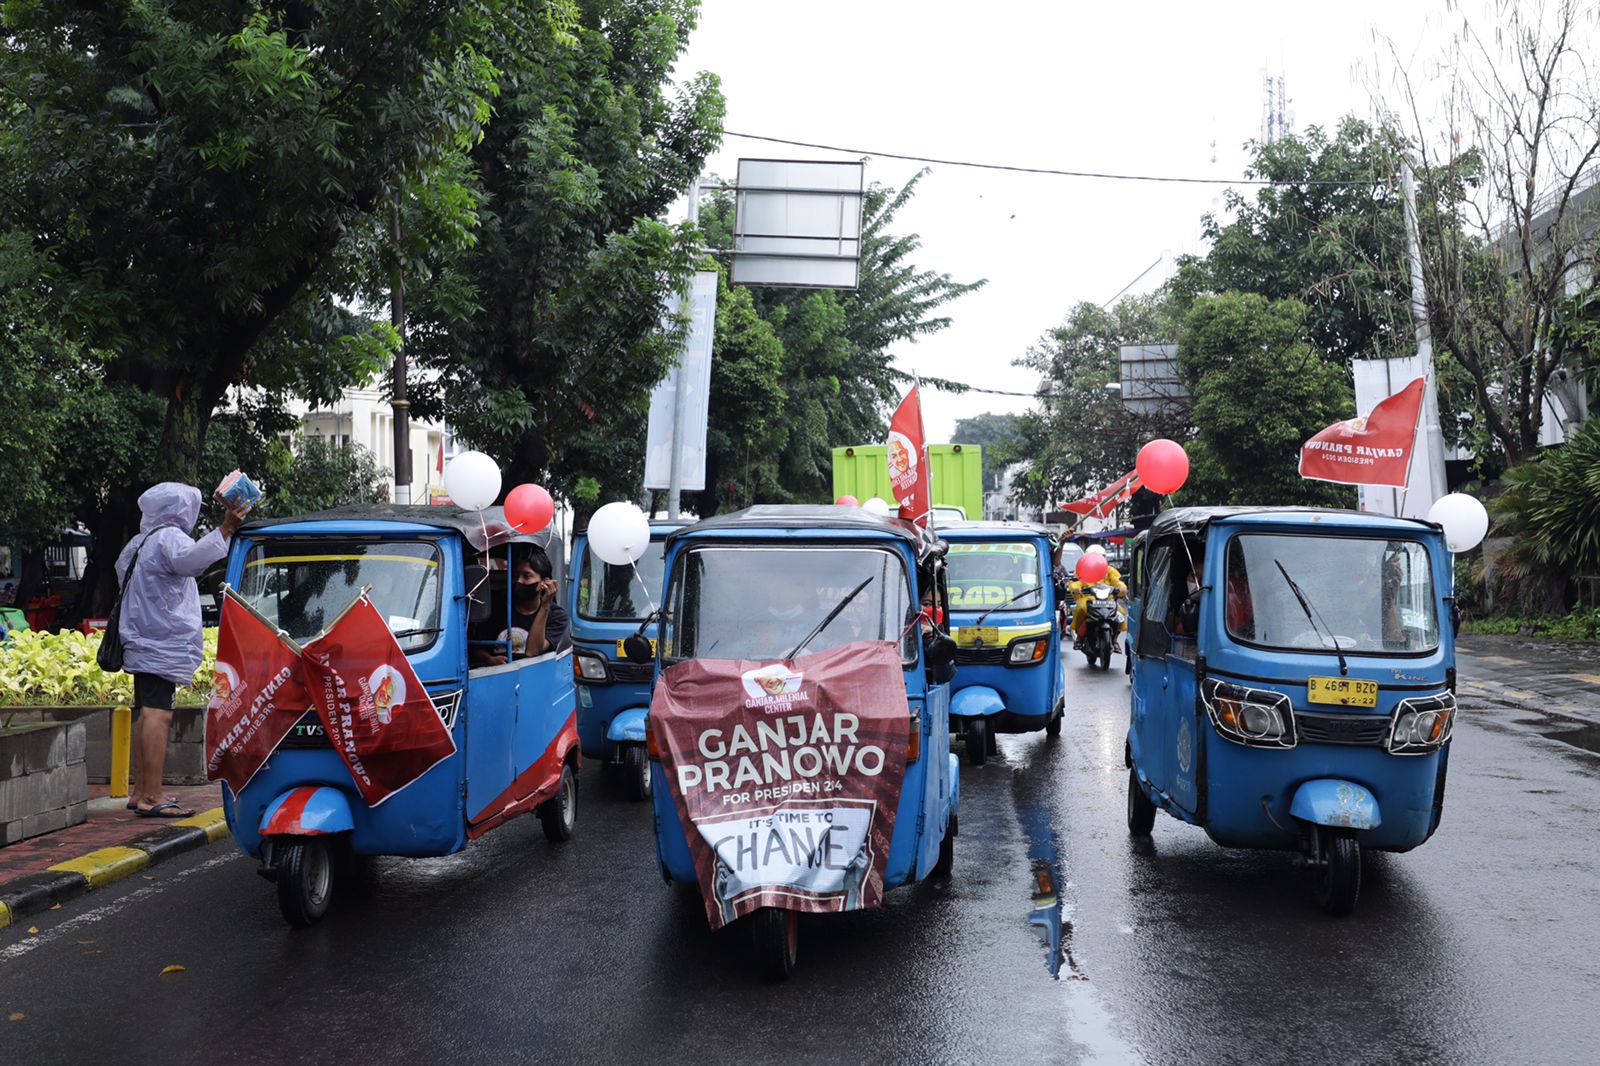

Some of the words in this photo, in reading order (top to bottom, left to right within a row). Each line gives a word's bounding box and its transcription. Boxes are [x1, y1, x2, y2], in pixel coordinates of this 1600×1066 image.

[1310, 680, 1317, 690] B
[1356, 683, 1376, 694] BZC
[323, 675, 337, 725] PRESIDEN
[764, 703, 793, 714] CENTER
[296, 724, 324, 736] TVS
[698, 712, 860, 760] GANJAR
[677, 745, 886, 796] PRANOWO
[722, 793, 750, 806] FOR
[754, 781, 821, 801] PRESIDEN
[749, 818, 774, 830] IT'S
[775, 813, 810, 824] TIME
[815, 812, 834, 824] TO
